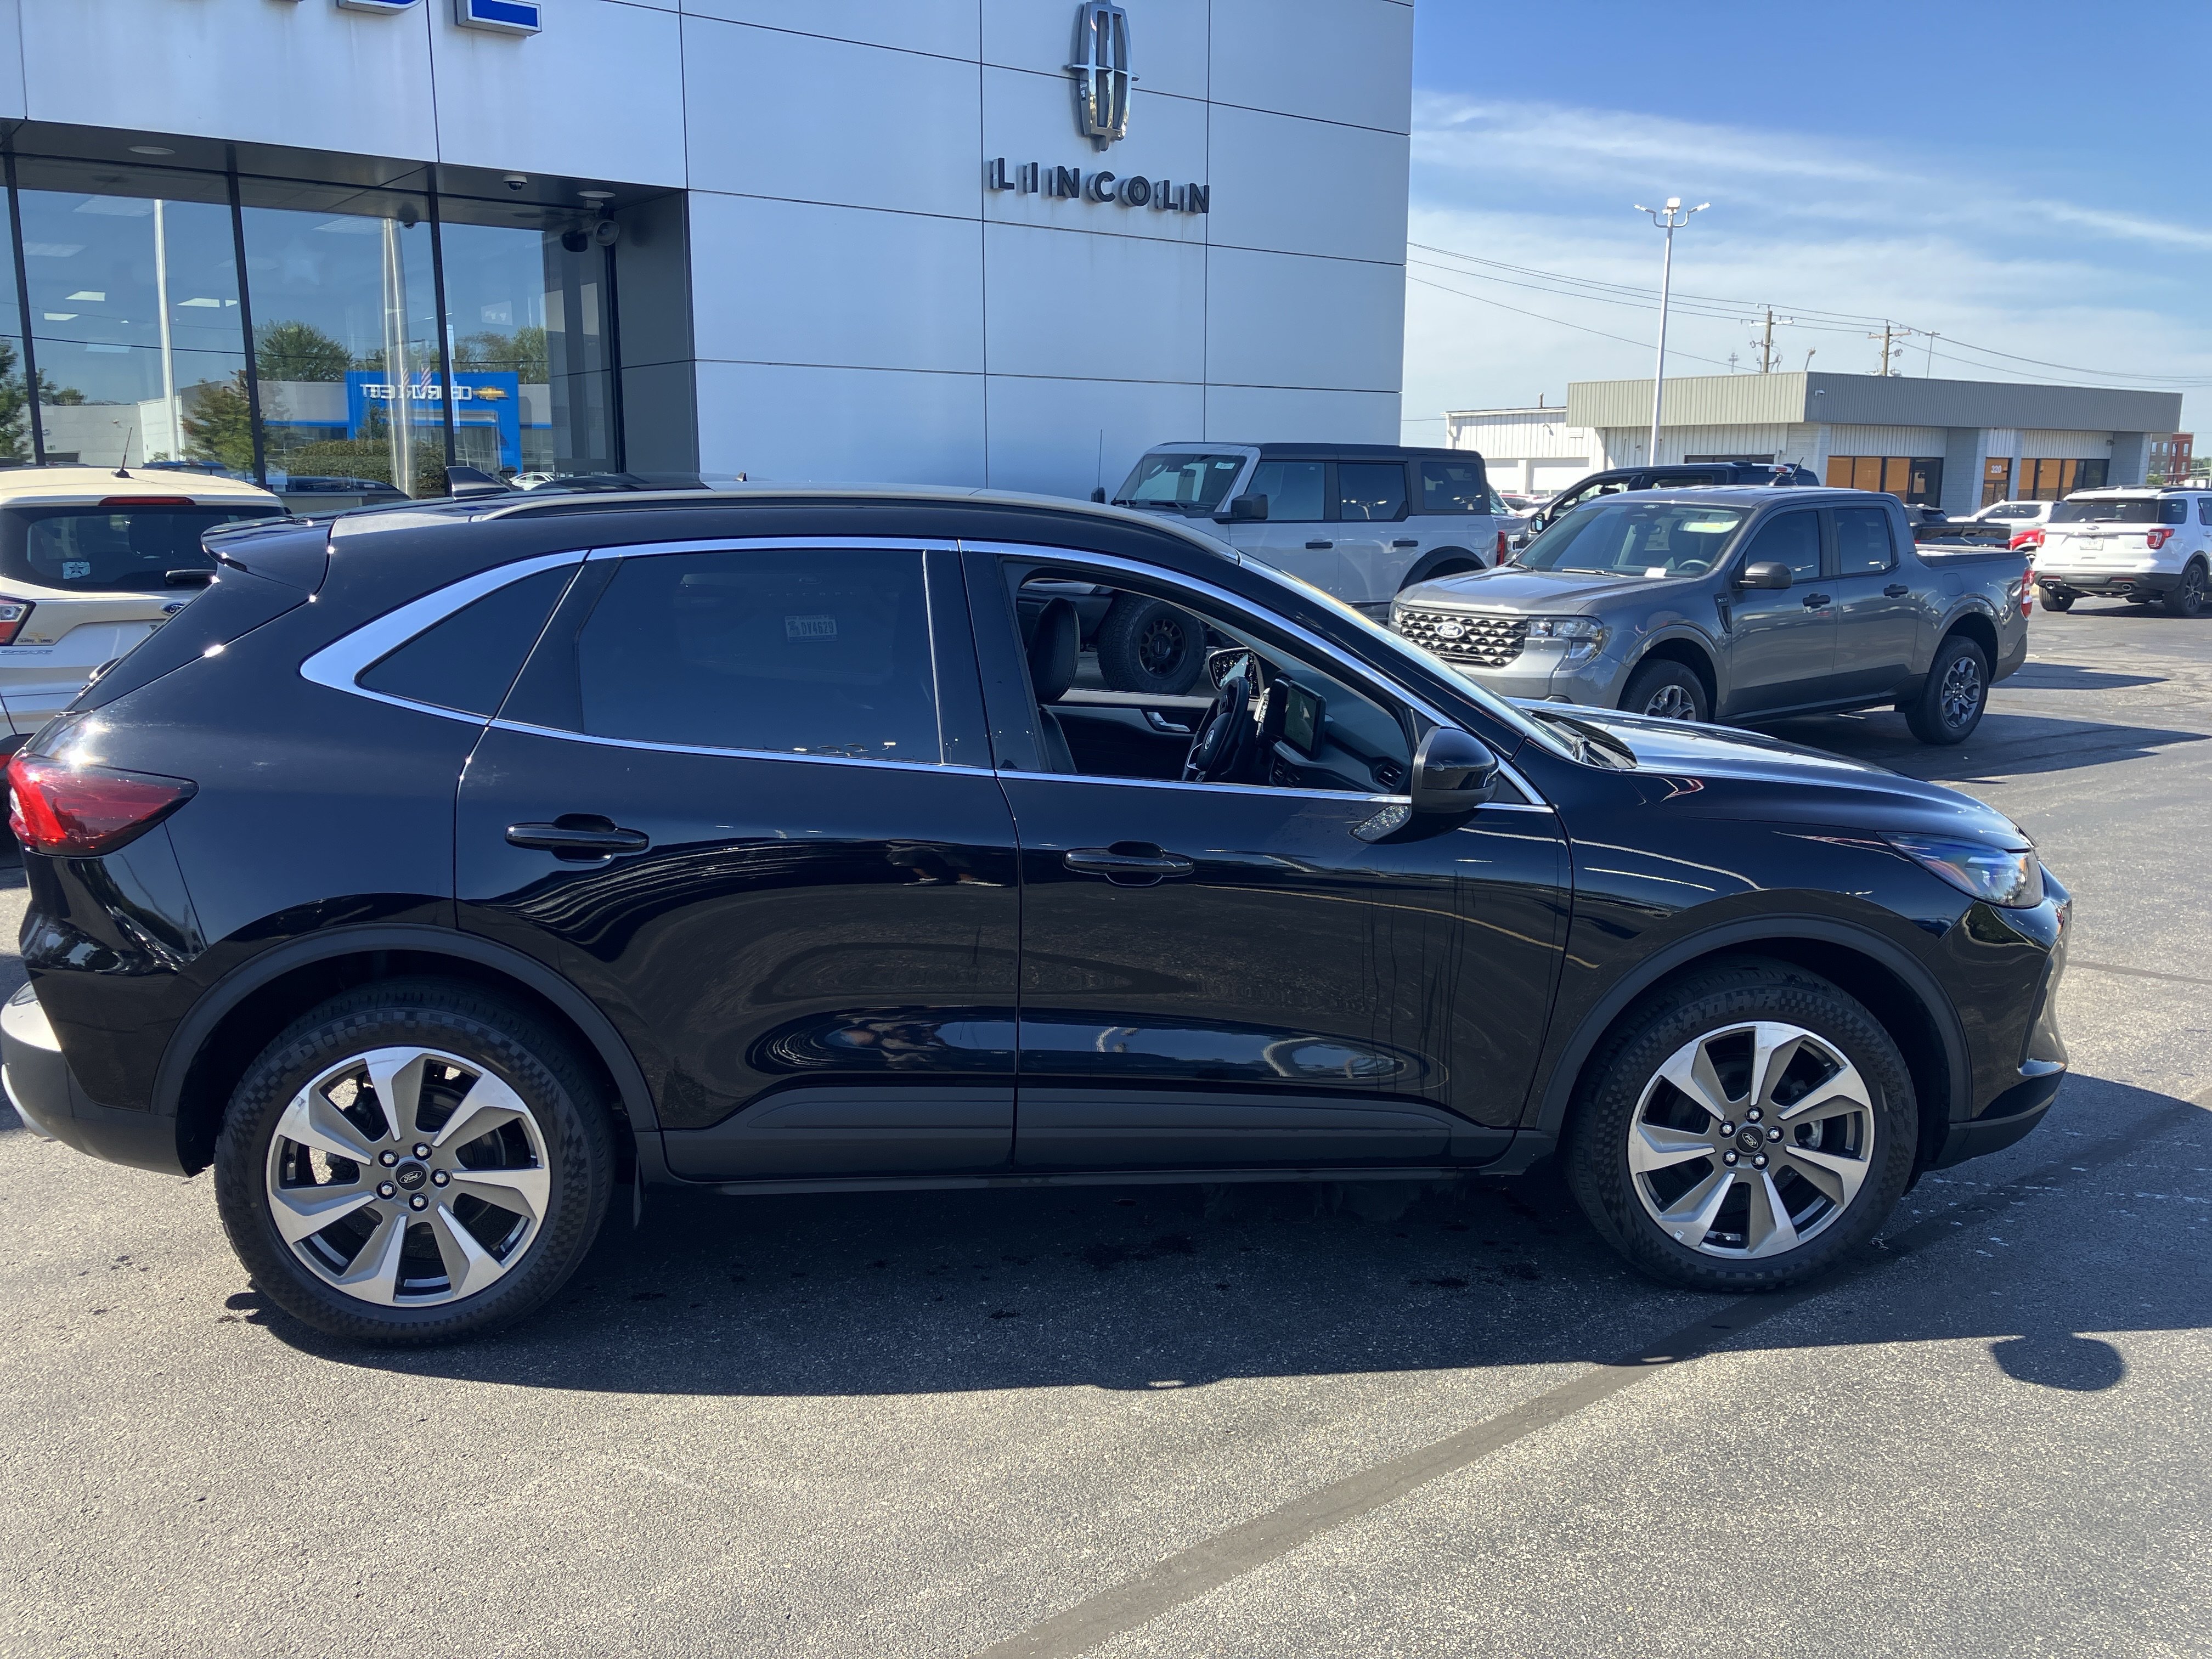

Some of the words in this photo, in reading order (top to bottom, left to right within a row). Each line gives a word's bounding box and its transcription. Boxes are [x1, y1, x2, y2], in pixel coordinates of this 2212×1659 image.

[992, 157, 1210, 213] LINCOLN
[1991, 465, 2002, 473] 320
[1438, 624, 1460, 636] Ford
[1743, 1134, 1757, 1147] Ford
[402, 1172, 419, 1182] Ford
